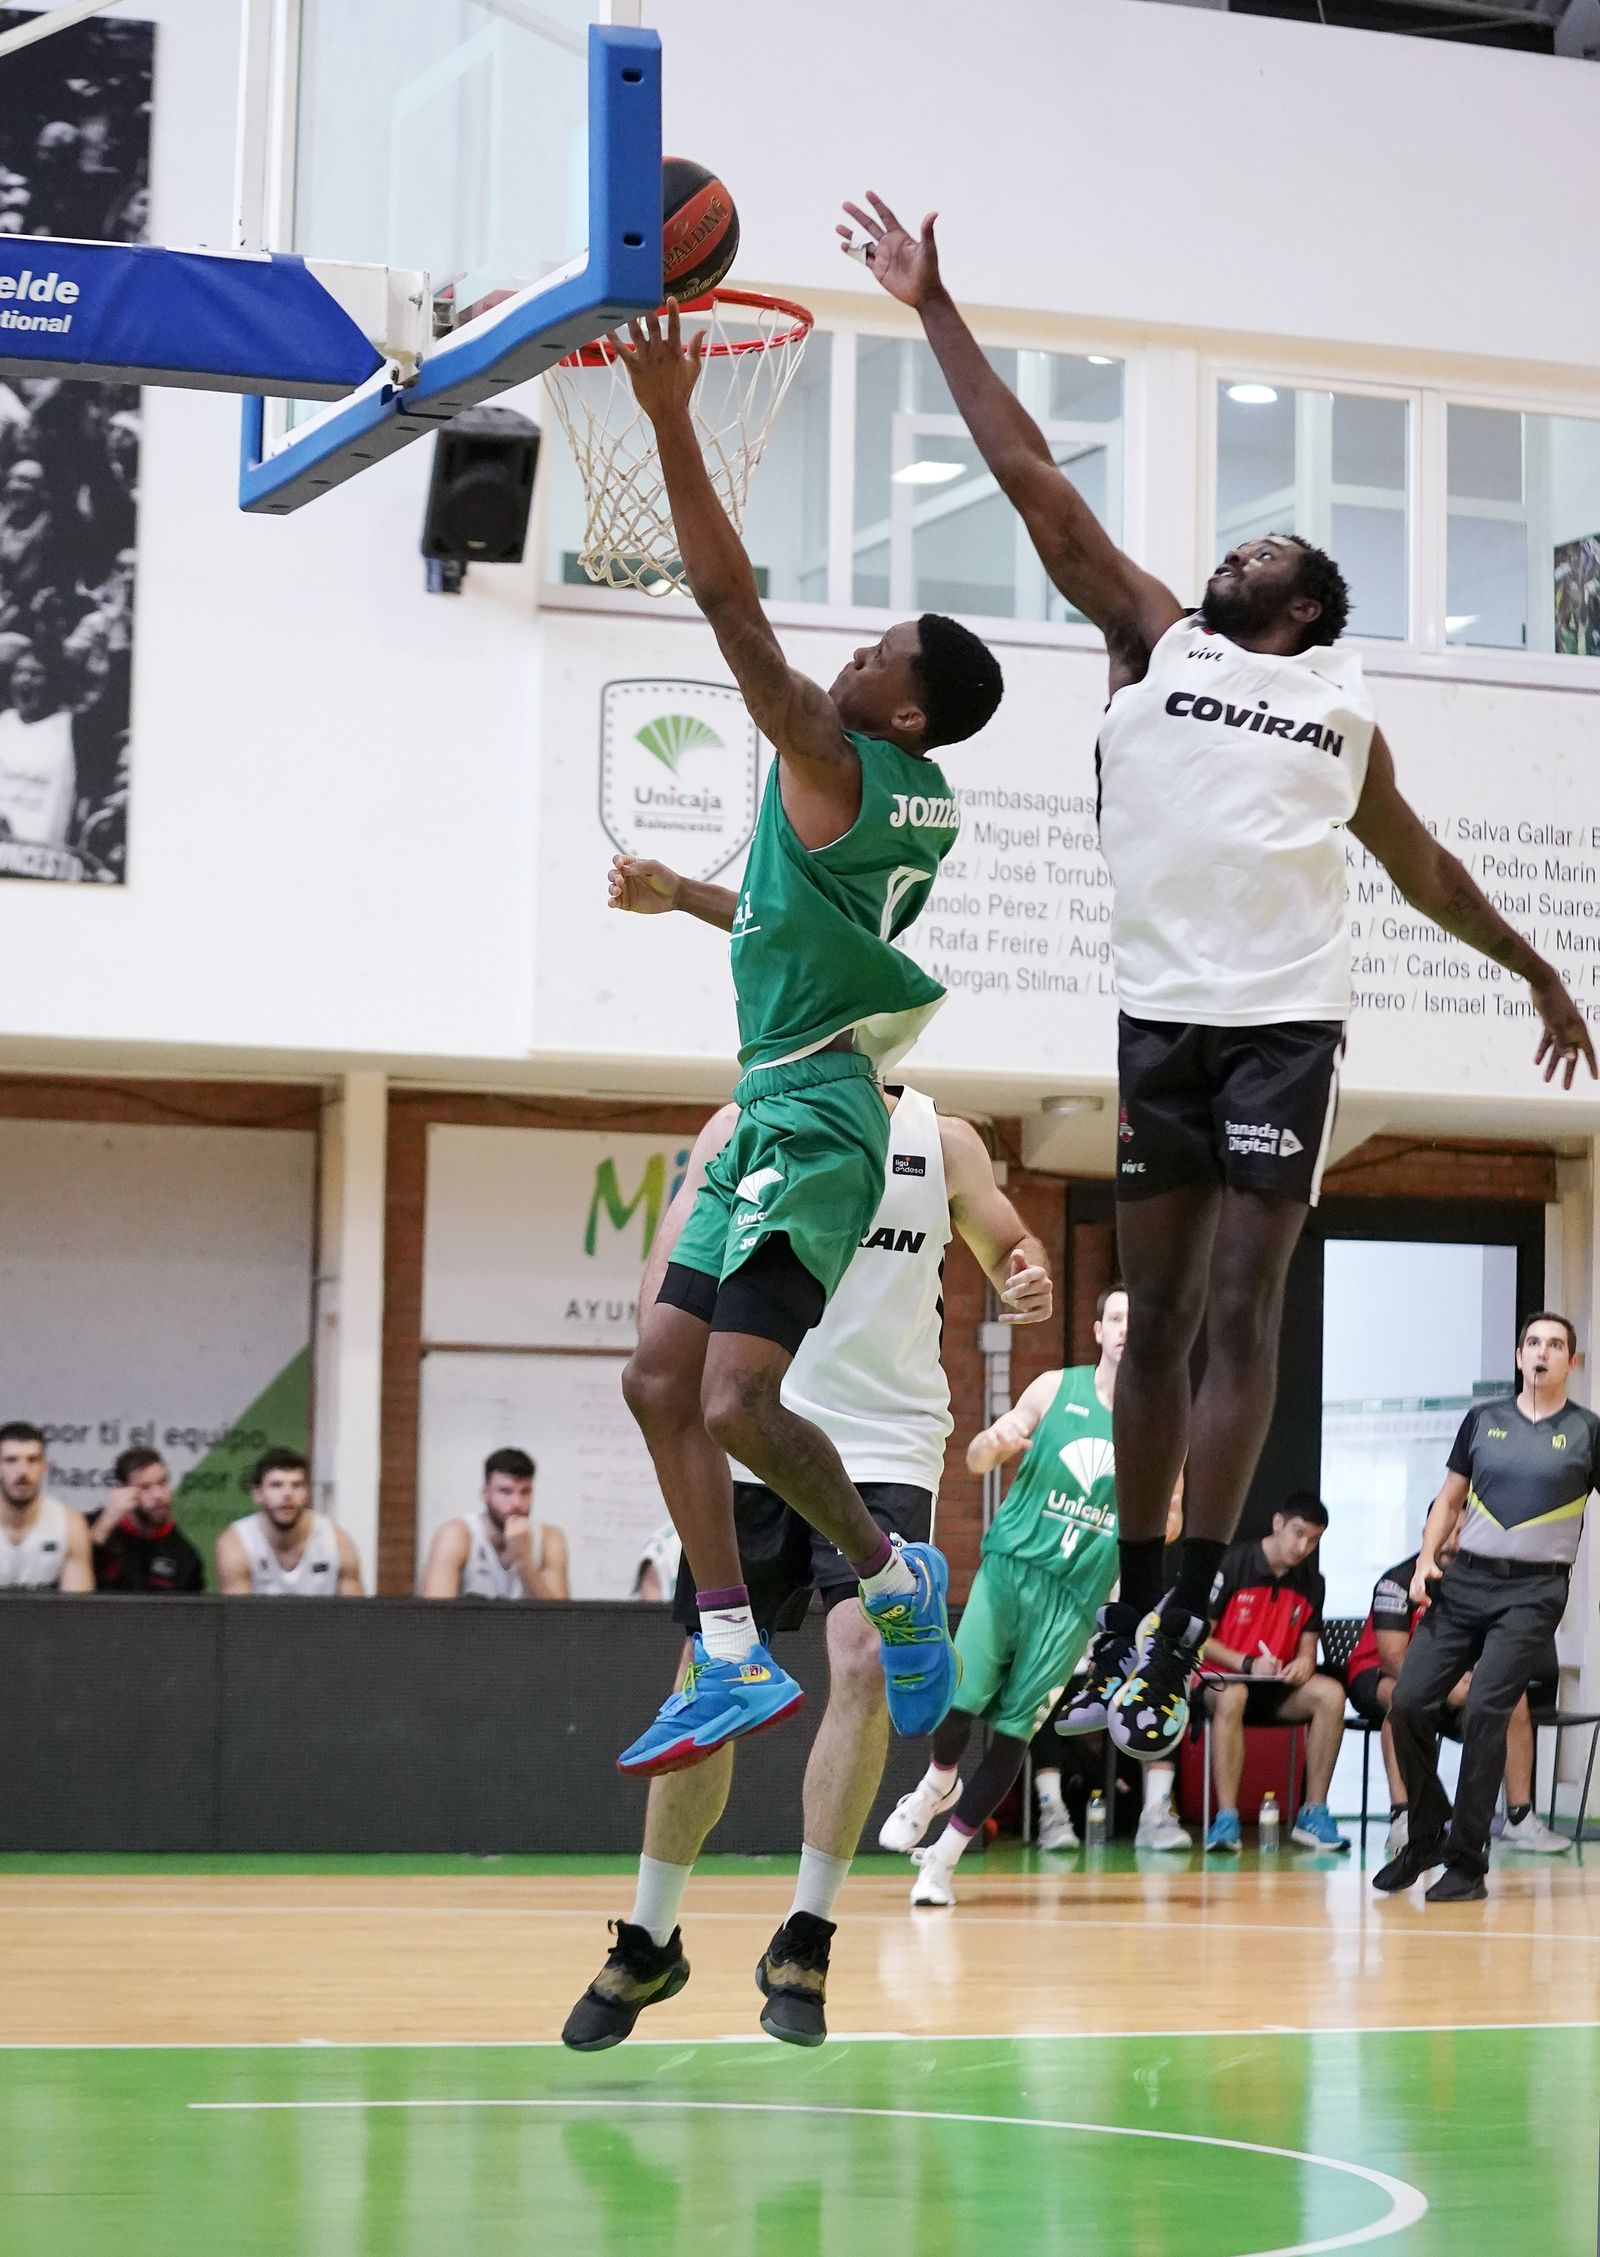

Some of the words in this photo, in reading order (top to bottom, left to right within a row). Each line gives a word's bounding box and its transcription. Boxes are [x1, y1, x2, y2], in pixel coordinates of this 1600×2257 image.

[663, 195, 729, 275] PALDING
[634, 785, 722, 812] Unicaja
[974, 821, 1040, 851] Miguel
[1457, 817, 1510, 843] Salva
[1517, 821, 1574, 847] Gallar
[988, 858, 1036, 883] José
[1482, 854, 1538, 880] Pedro
[988, 893, 1049, 920] Pérez
[929, 926, 979, 951] Rafa
[987, 929, 1049, 955] Freire
[1016, 966, 1078, 994] Stilma
[1407, 953, 1470, 979] Carlos
[1478, 958, 1501, 981] de
[1425, 990, 1487, 1013] Ismael
[737, 1210, 768, 1226] Unic
[1048, 1489, 1116, 1528] Unicaja
[1060, 1522, 1081, 1560] 4
